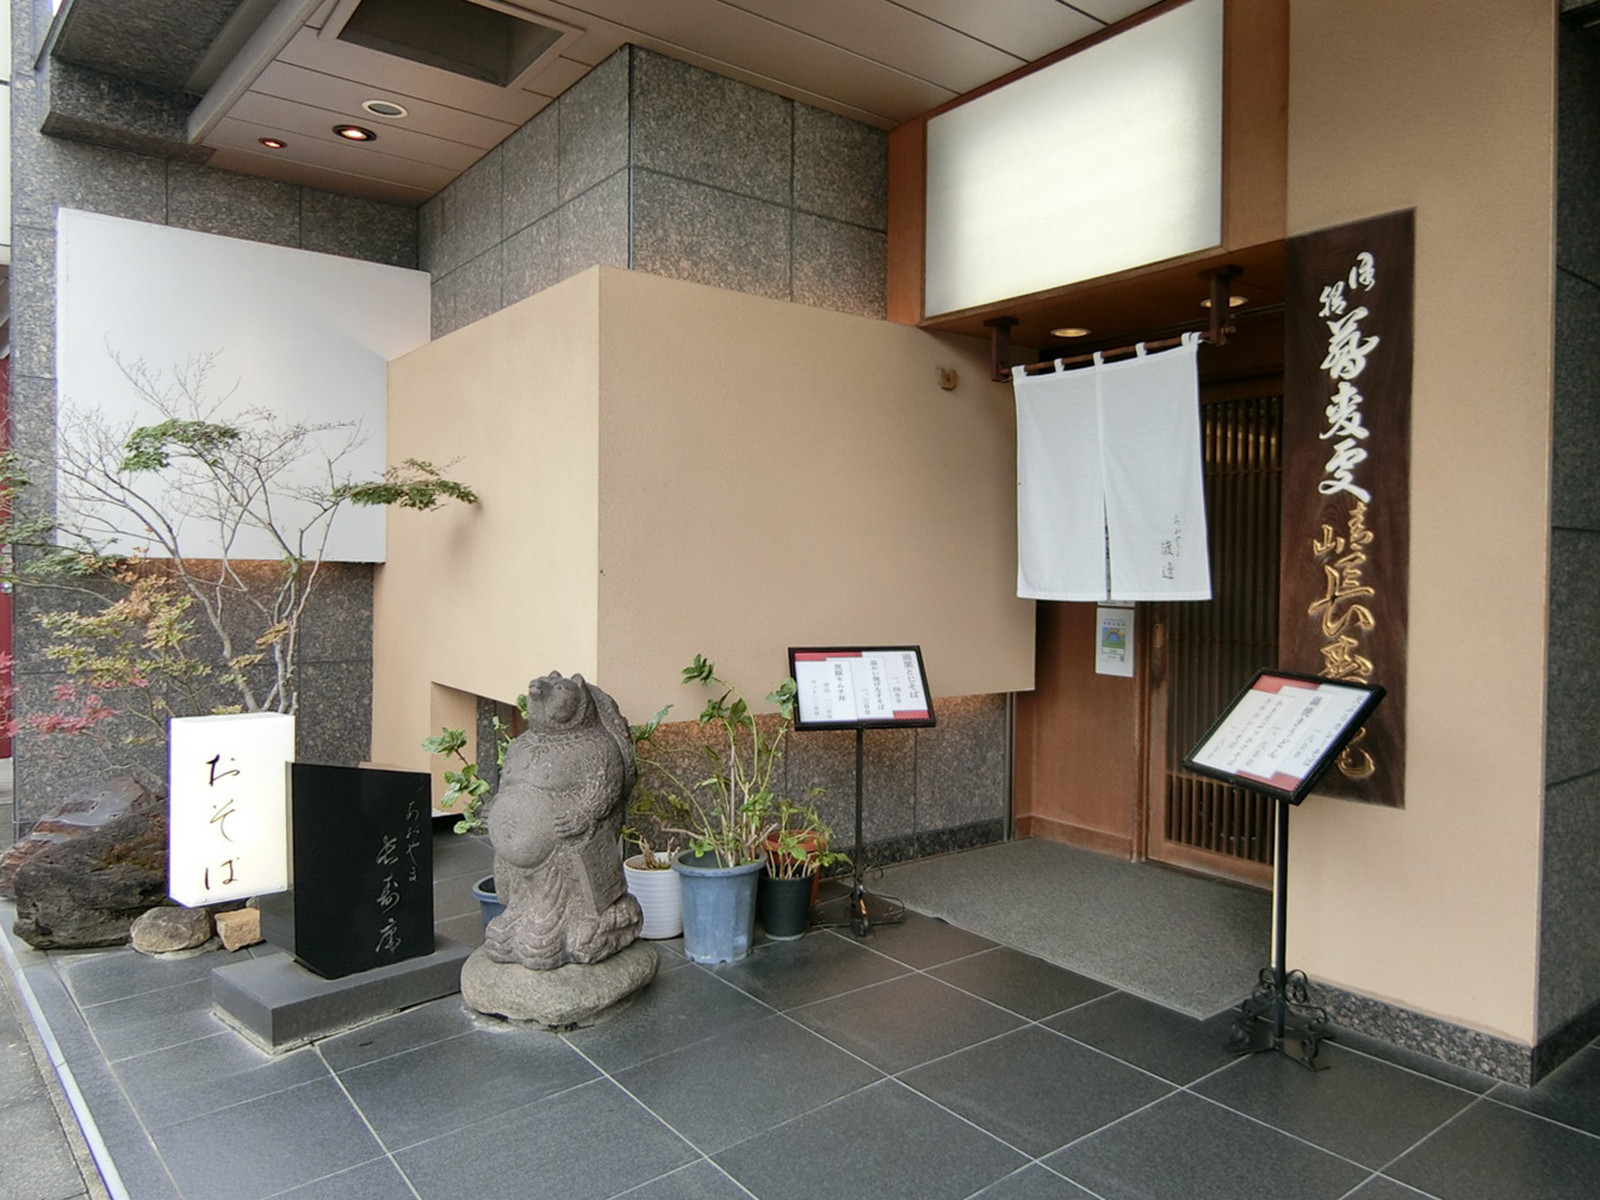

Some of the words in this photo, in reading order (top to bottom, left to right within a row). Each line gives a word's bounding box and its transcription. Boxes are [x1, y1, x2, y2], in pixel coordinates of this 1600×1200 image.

[205, 753, 241, 891] おそば
[405, 800, 421, 883] あおやま
